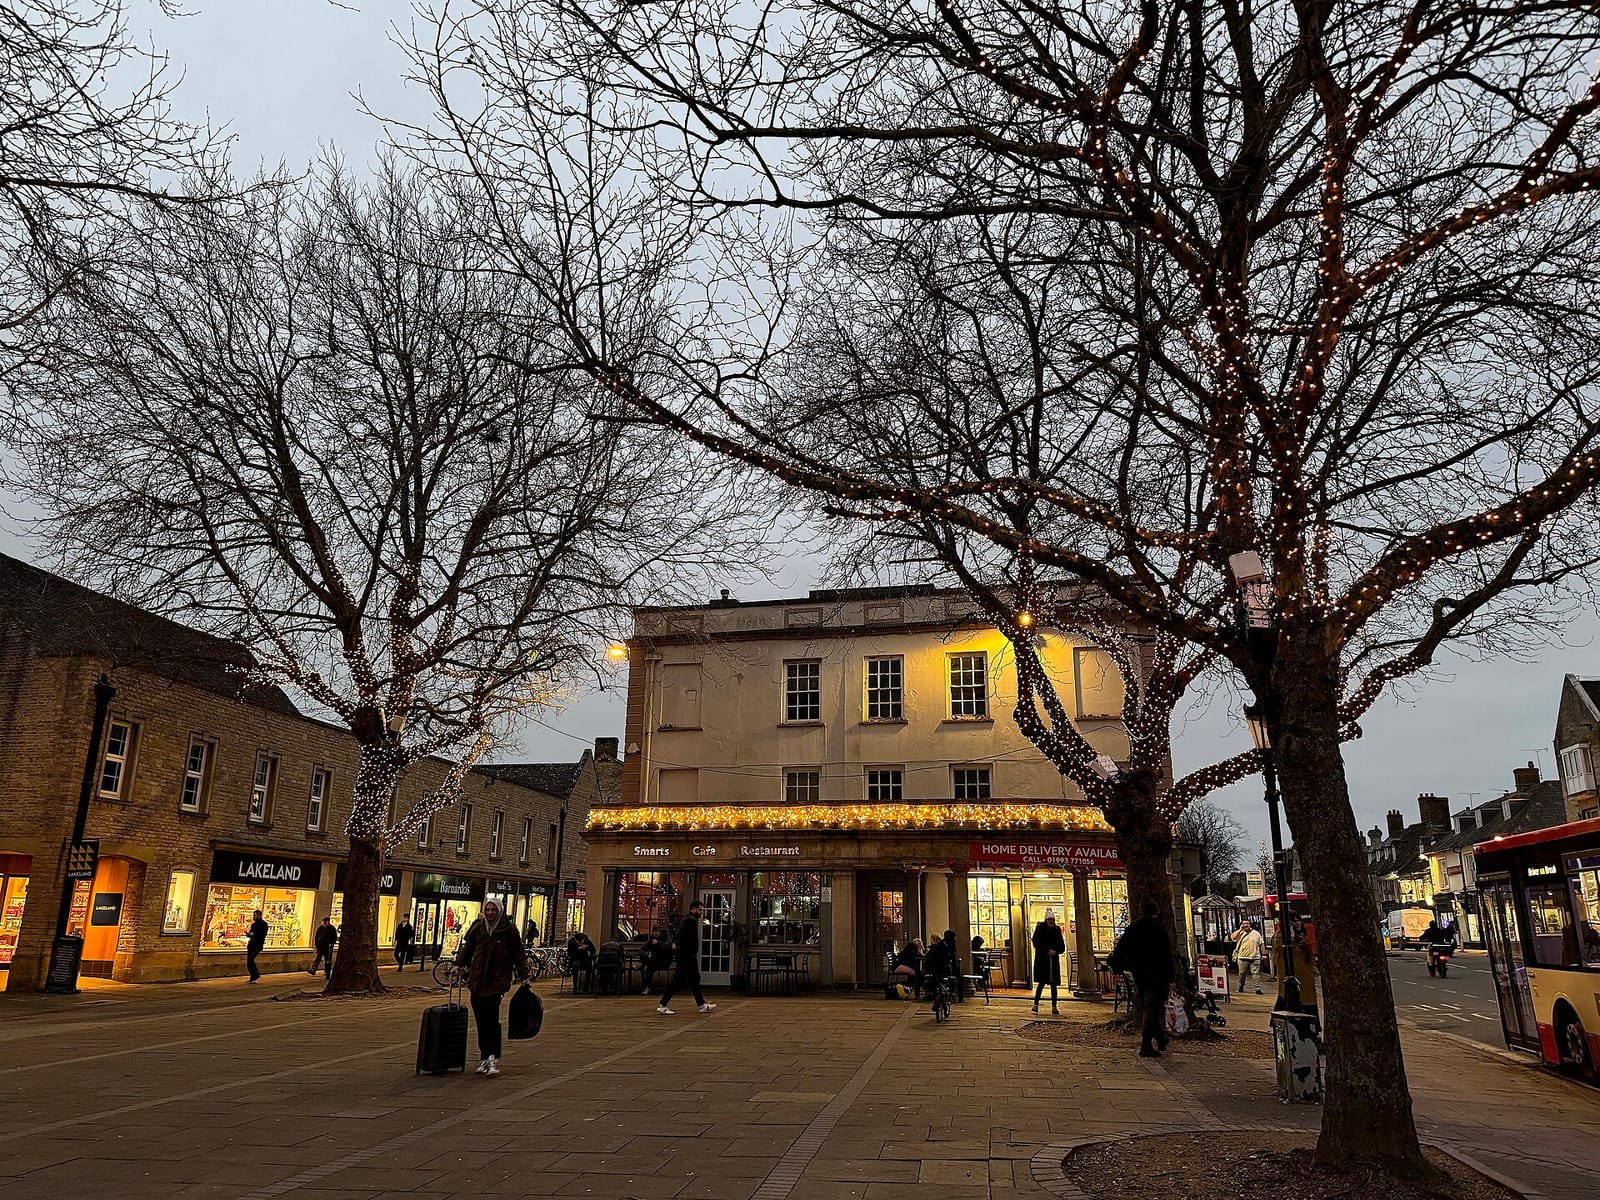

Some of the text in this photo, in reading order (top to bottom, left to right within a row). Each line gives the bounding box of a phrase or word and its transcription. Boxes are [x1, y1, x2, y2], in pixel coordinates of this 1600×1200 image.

[634, 846, 670, 856] Smarts
[740, 845, 800, 856] Restaurant
[982, 844, 1119, 859] HOME DELIVERY AVAILAB
[1047, 856, 1069, 864] 01993
[238, 861, 301, 881] LAKELAND
[440, 880, 470, 895] Barnardo's
